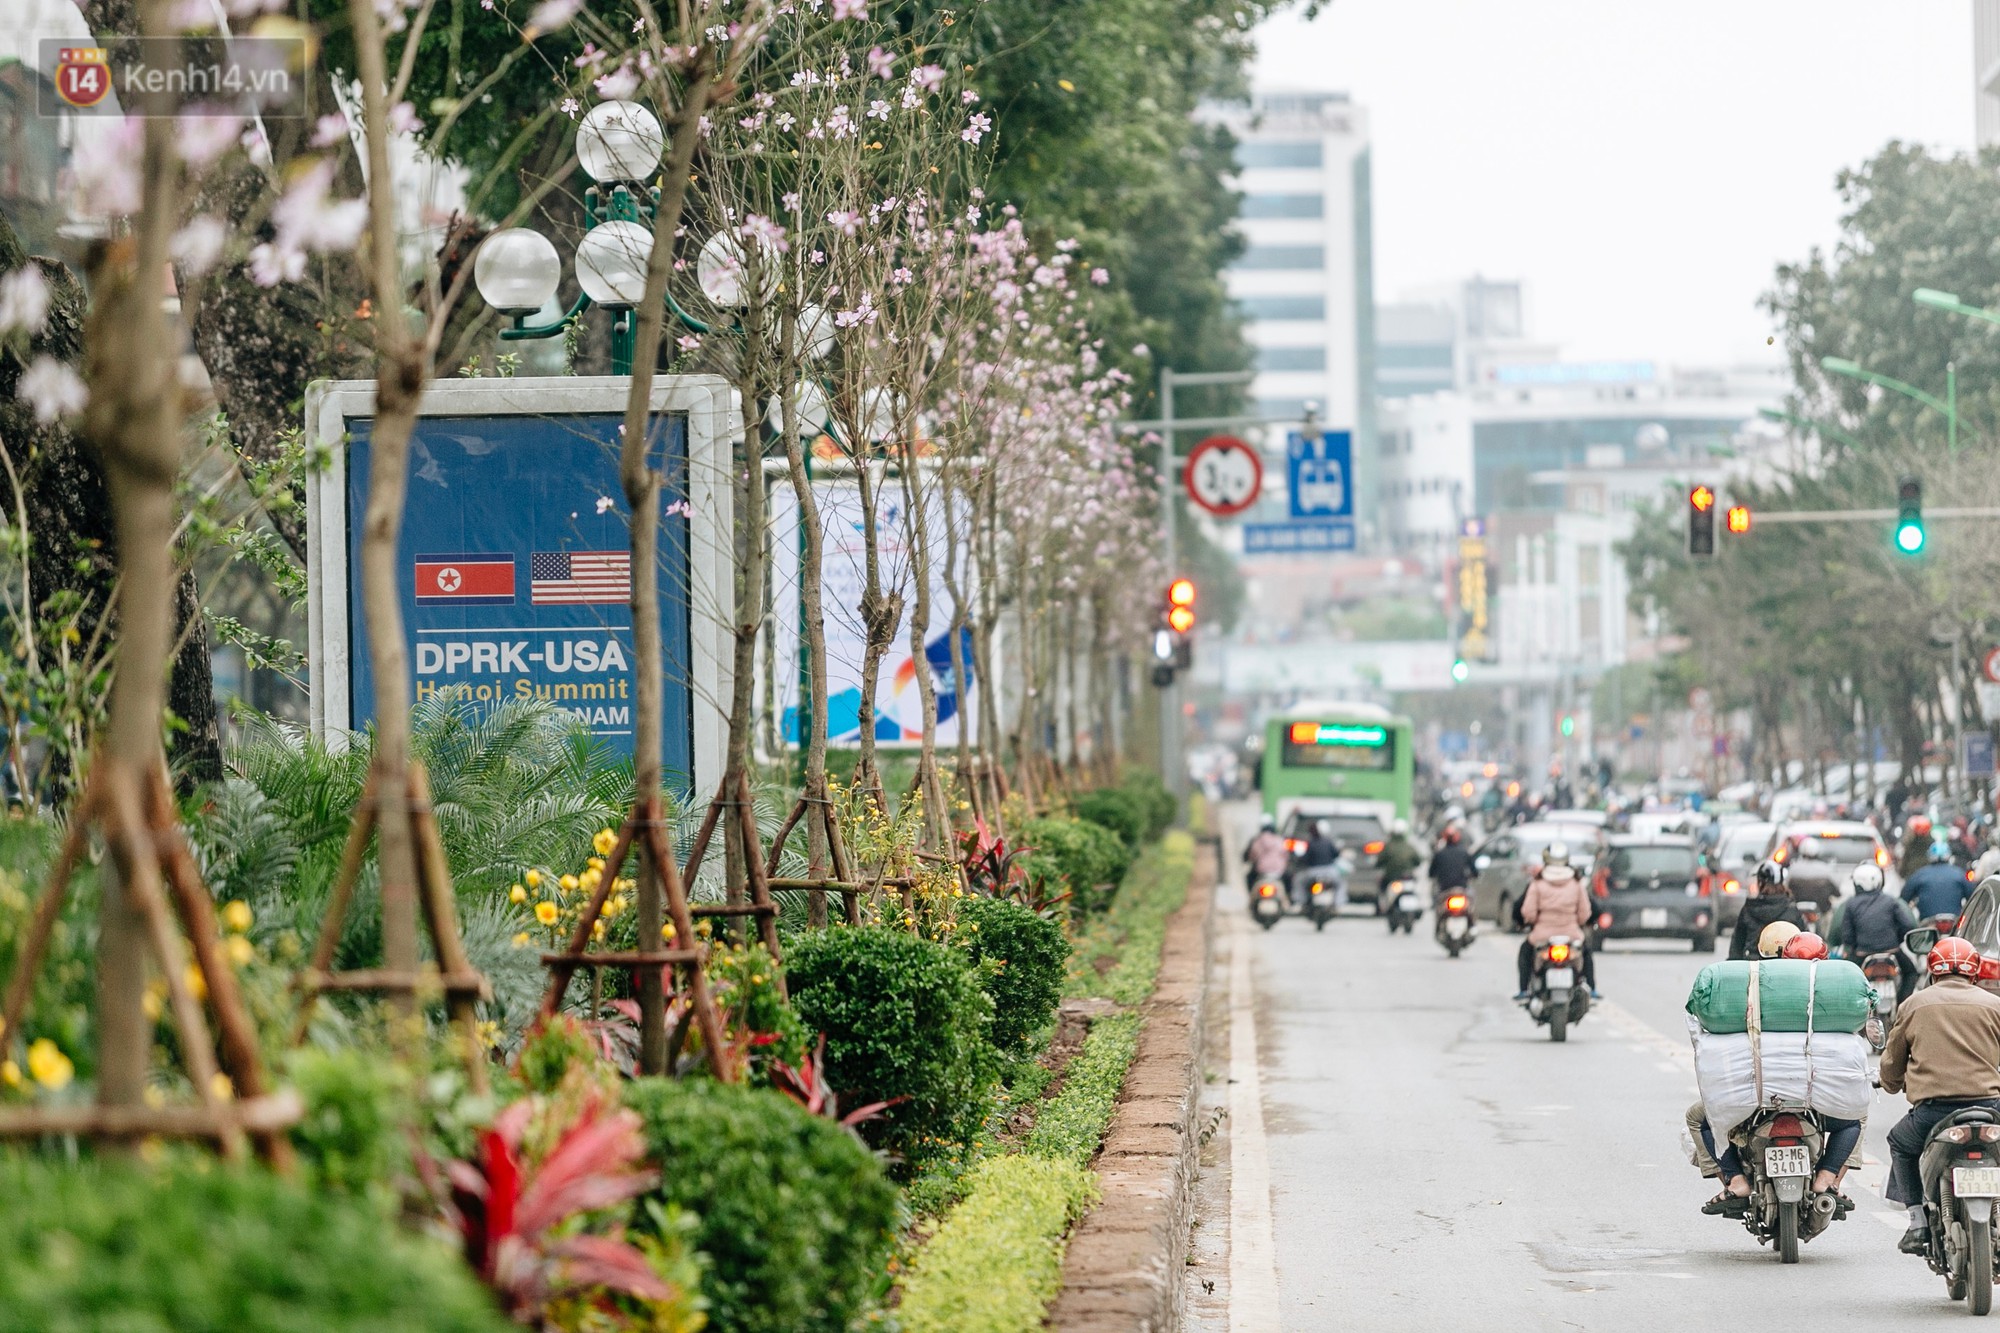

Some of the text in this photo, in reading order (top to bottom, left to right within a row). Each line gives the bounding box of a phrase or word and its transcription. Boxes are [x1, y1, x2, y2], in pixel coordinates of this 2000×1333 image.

[416, 640, 629, 674] DPRK-USA
[515, 678, 629, 700] Summit
[1771, 1148, 1804, 1161] 33-M6
[1772, 1161, 1804, 1174] 3401
[1961, 1169, 1994, 1181] 29-B1
